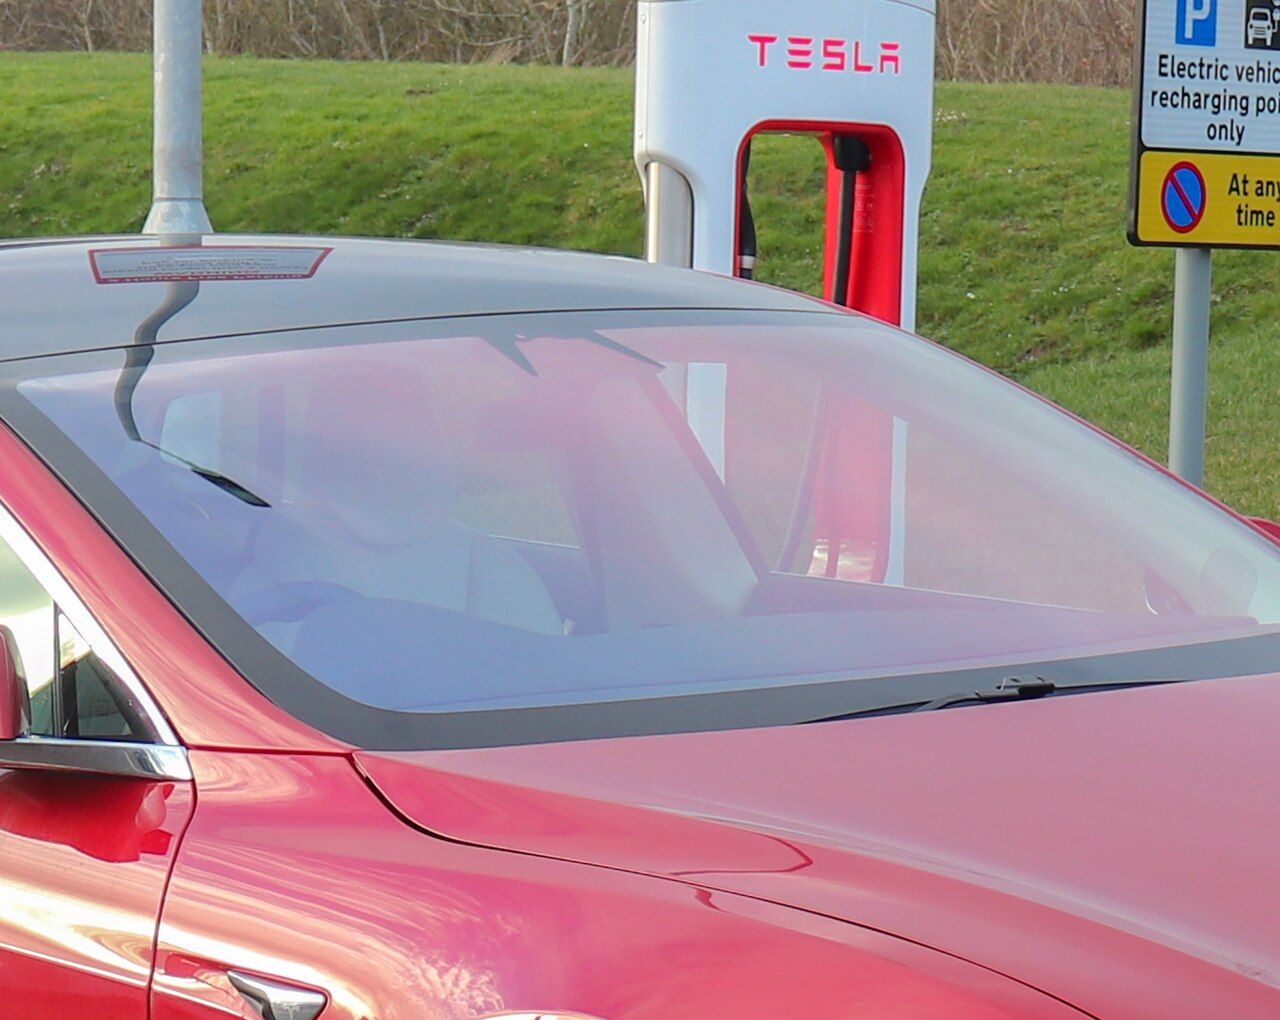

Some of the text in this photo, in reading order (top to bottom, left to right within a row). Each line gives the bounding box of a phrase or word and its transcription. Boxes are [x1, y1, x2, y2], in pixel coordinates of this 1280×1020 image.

[747, 35, 901, 74] TESLA
[1158, 54, 1229, 81] Electric
[1150, 86, 1249, 117] recharging
[1207, 119, 1246, 146] only
[1228, 173, 1249, 197] At
[1236, 204, 1275, 227] time
